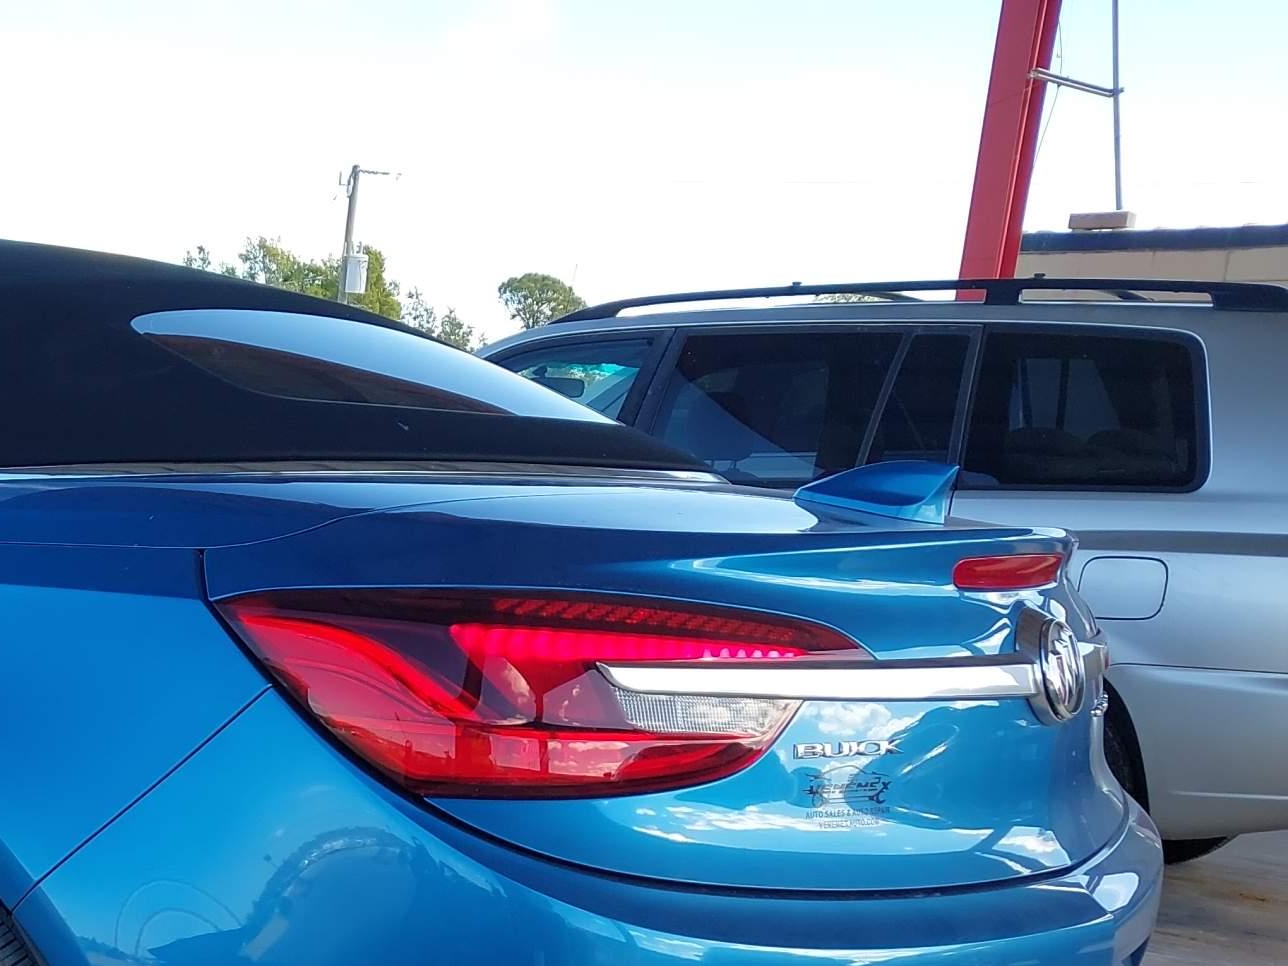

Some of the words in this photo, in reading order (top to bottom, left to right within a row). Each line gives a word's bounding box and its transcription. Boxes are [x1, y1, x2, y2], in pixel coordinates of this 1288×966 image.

[793, 740, 905, 760] BUICK
[805, 809, 824, 819] AUTO
[824, 808, 846, 818] SALES
